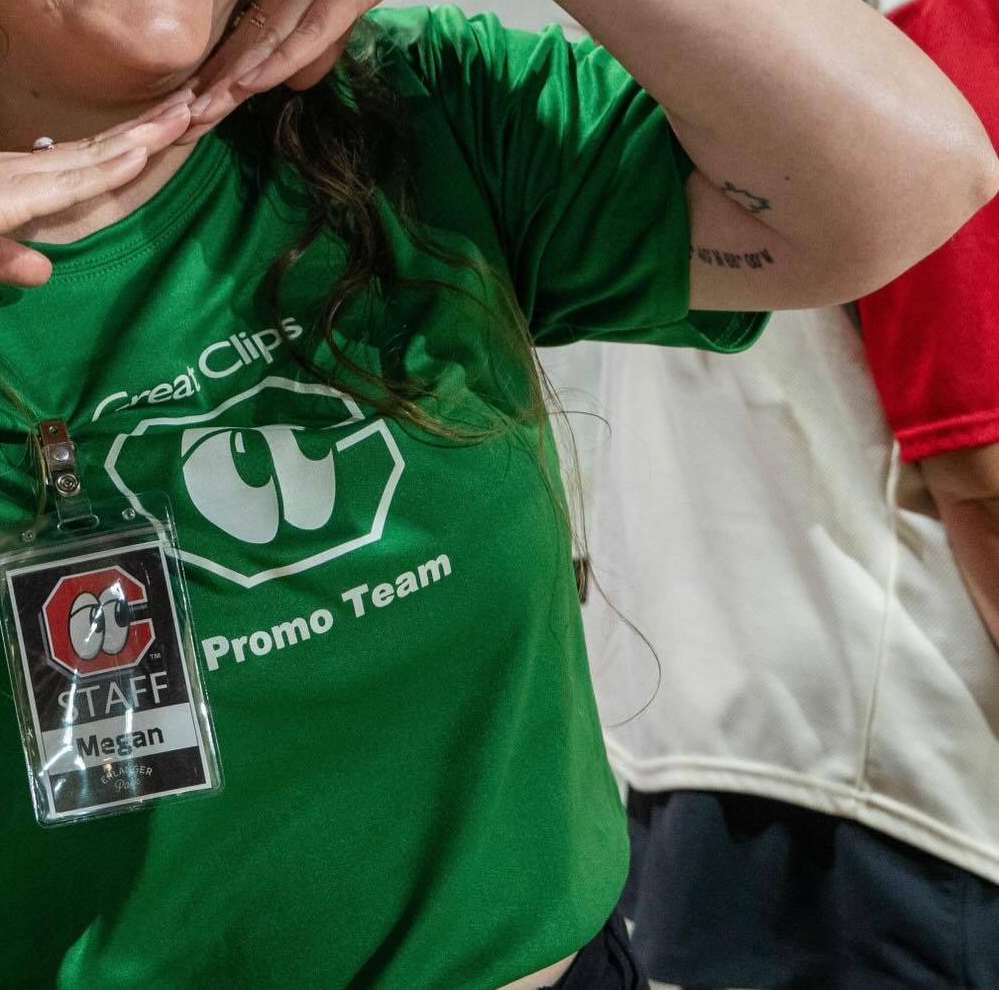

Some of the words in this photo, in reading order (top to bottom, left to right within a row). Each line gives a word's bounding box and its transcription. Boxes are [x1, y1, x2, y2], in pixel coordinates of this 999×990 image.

[198, 317, 303, 379] Clips
[201, 609, 334, 672] Promo
[341, 554, 452, 618] Team
[57, 671, 168, 723] STAFF
[76, 726, 164, 758] Megan
[101, 765, 153, 784] ERLAGER
